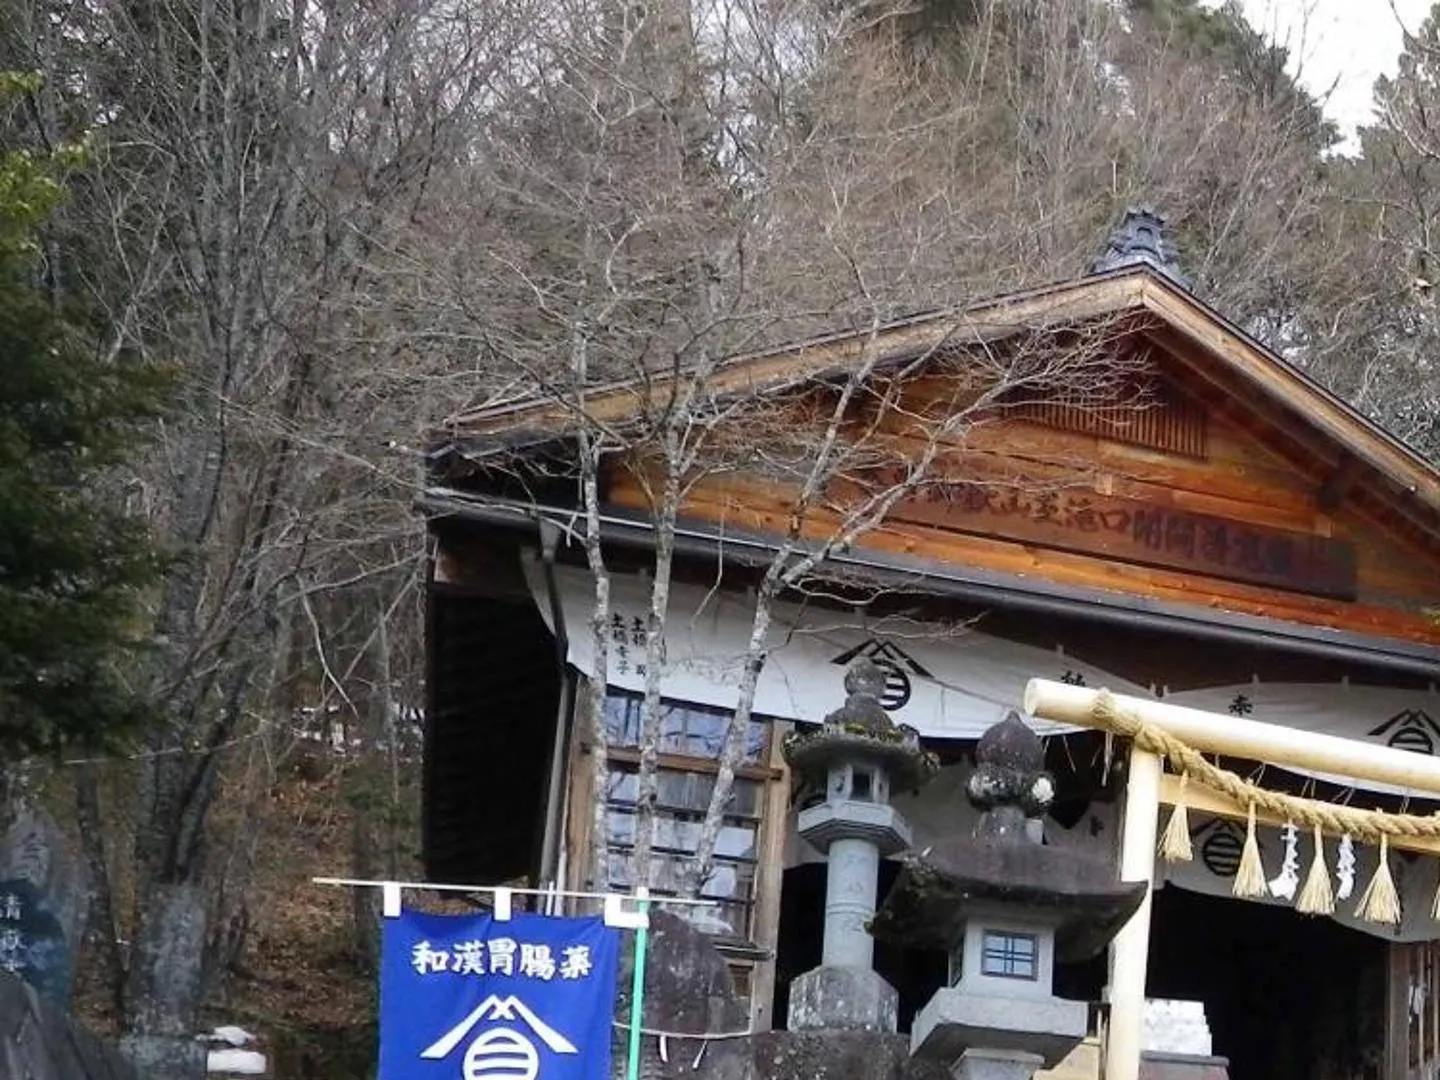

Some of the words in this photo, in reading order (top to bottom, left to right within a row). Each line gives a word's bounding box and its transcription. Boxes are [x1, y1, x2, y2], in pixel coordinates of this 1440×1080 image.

[411, 937, 593, 981] 和漢胃腸薬
